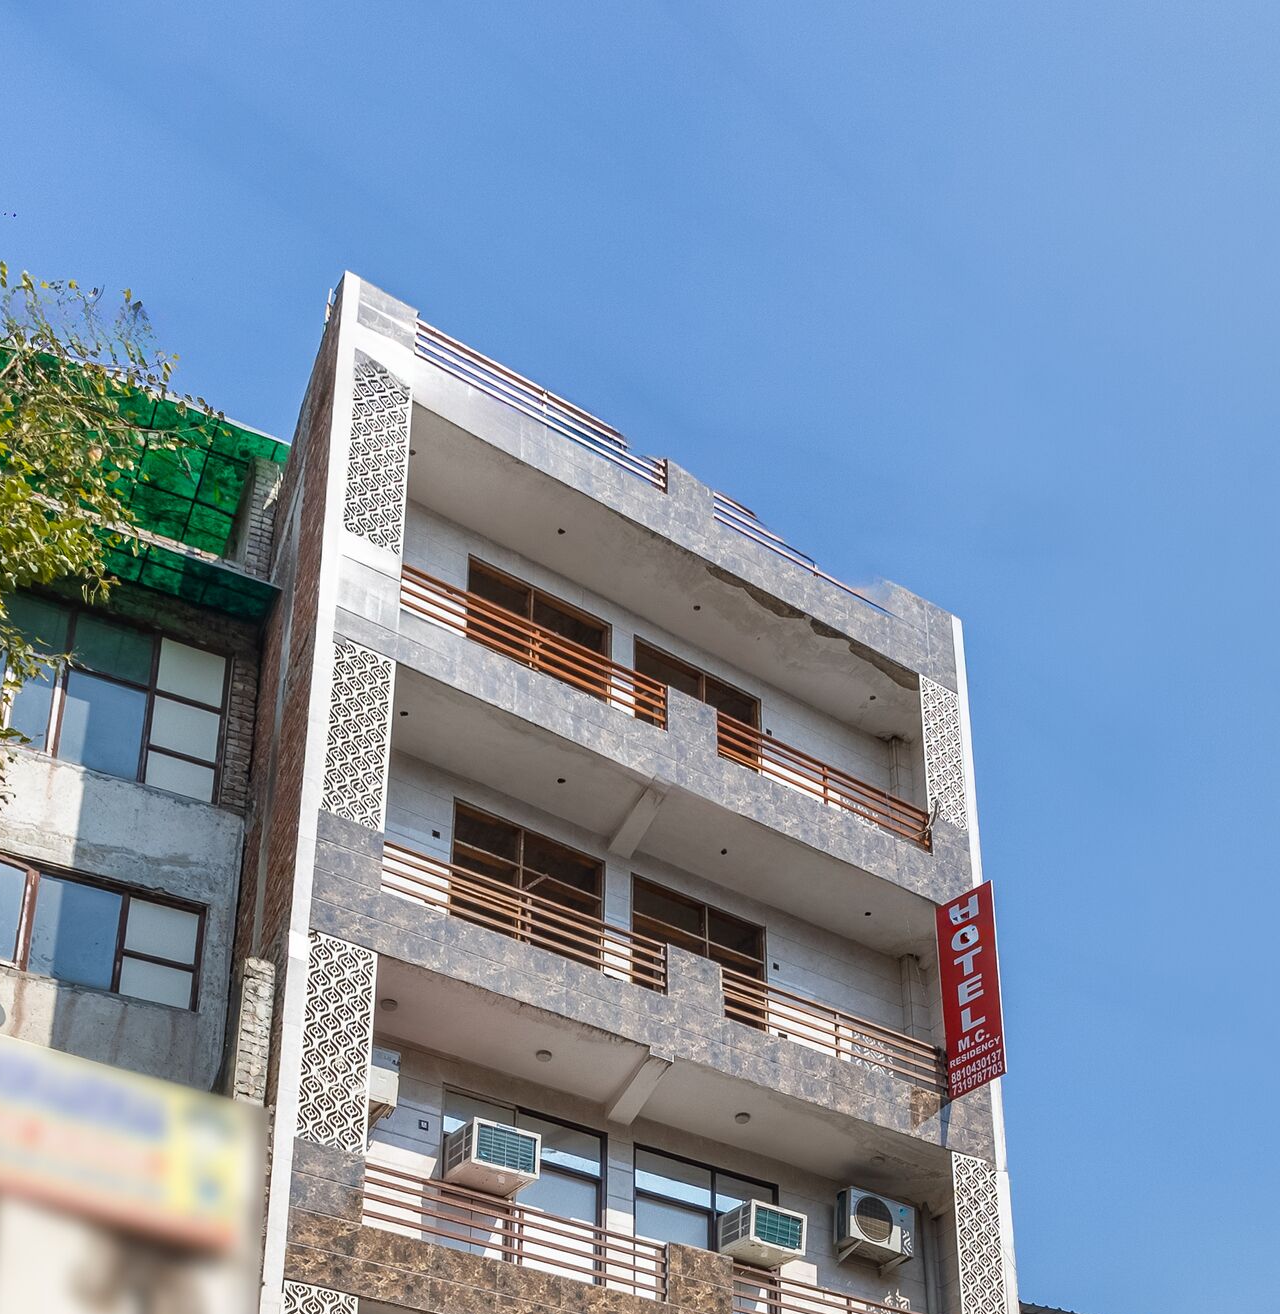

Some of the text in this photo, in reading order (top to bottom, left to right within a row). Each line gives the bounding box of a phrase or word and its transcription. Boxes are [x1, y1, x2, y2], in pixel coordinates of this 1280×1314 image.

[950, 1036, 1000, 1068] RESIDENCY
[957, 1029, 990, 1052] M.C.
[951, 1049, 1002, 1084] 8810430137
[952, 1061, 1003, 1096] 7319787703
